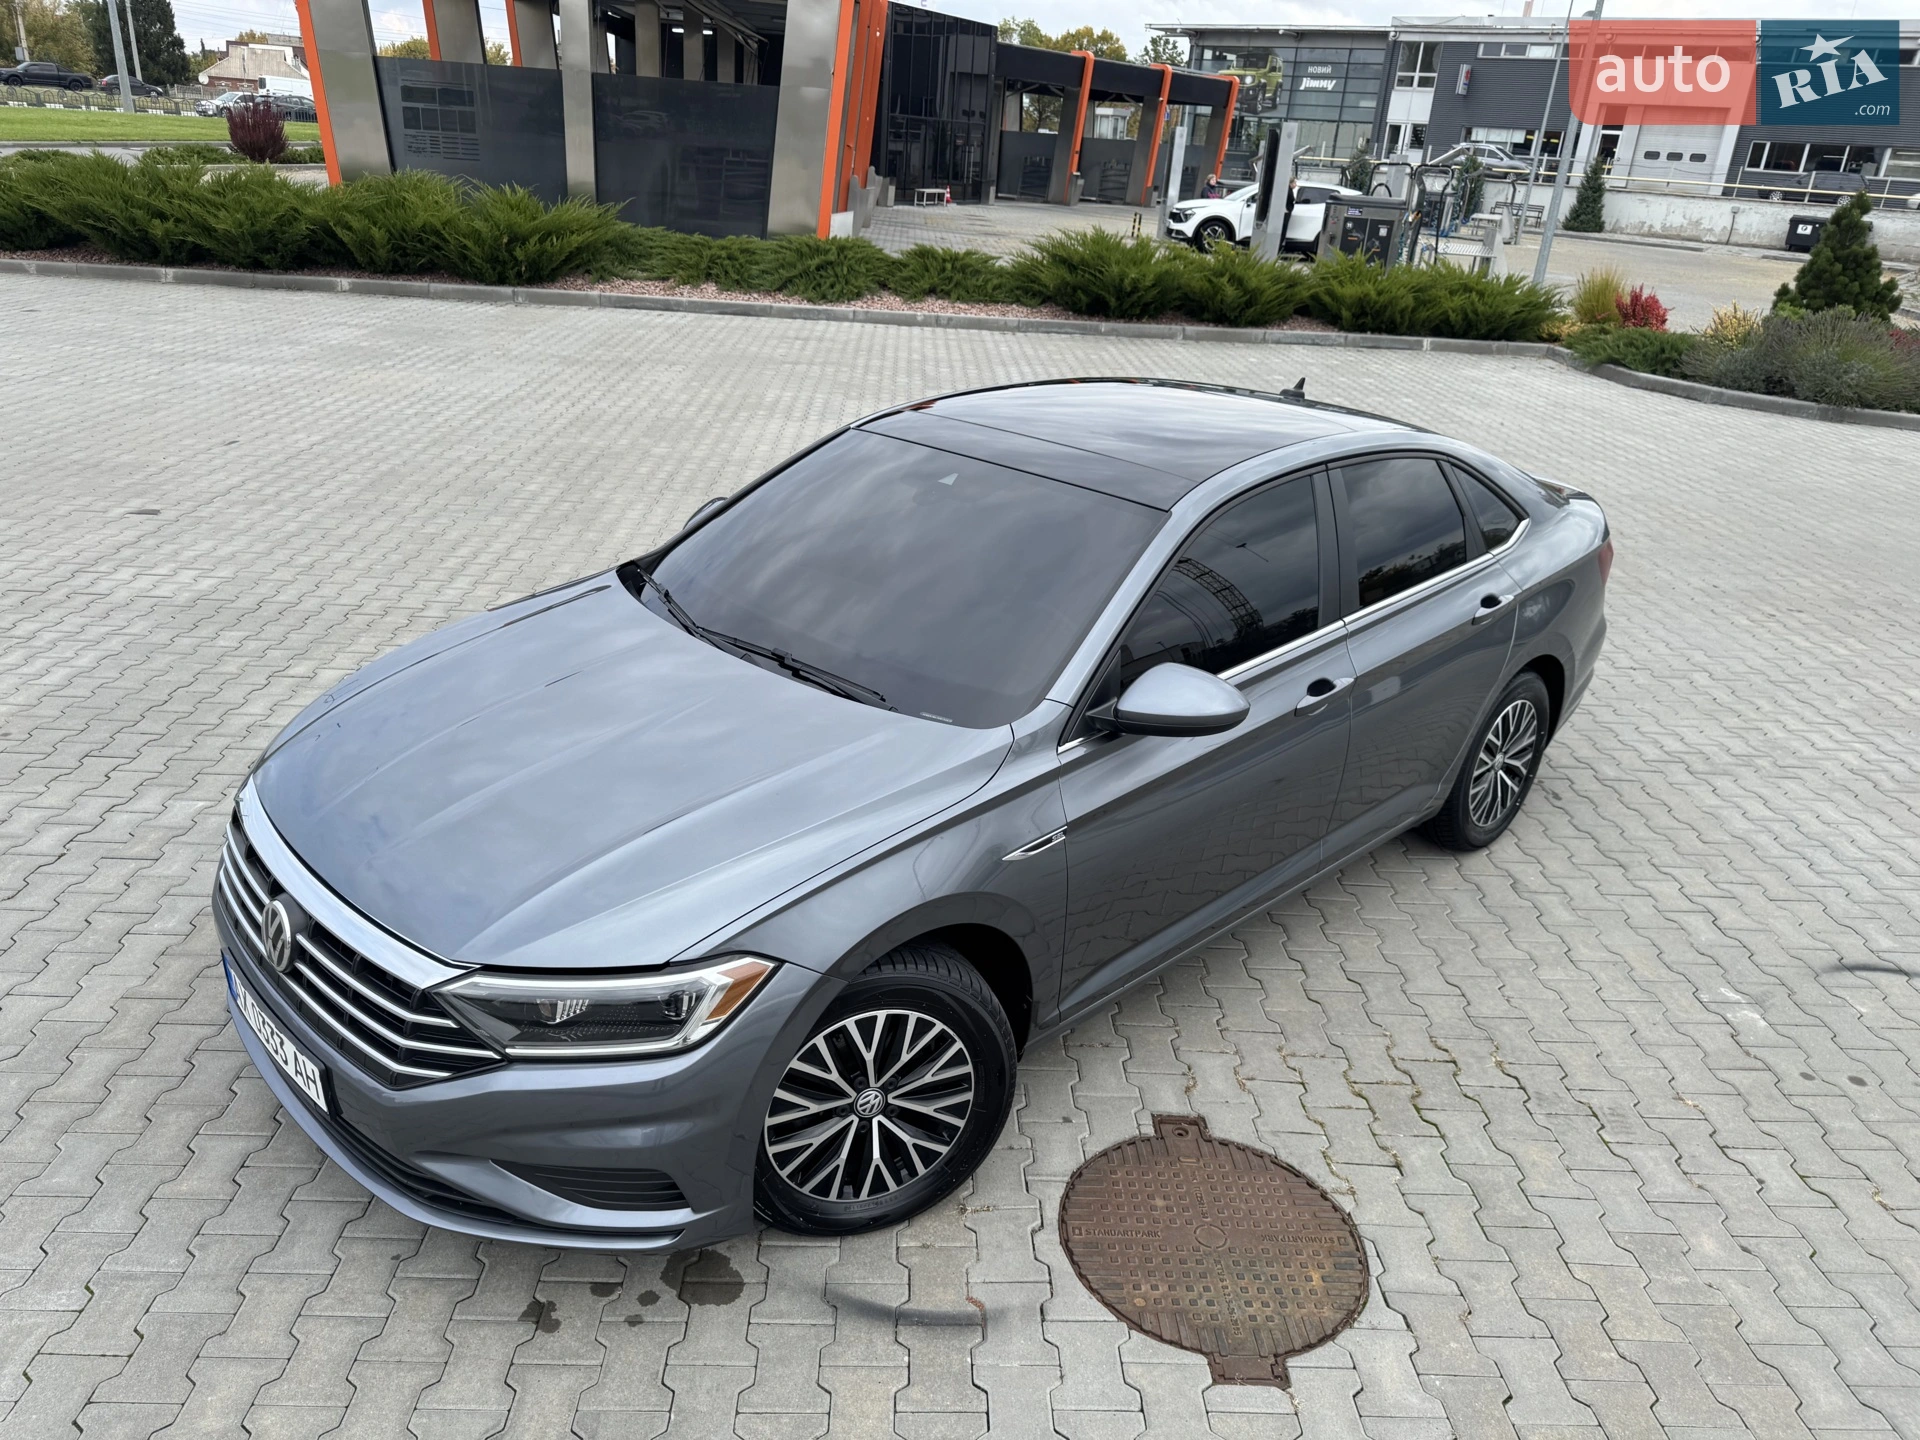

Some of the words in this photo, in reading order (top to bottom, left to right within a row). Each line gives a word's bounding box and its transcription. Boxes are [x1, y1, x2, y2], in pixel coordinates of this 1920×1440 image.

[1307, 64, 1332, 74] НОВИЙ
[251, 1001, 288, 1067] 0333
[294, 1050, 320, 1100] AH
[1085, 1227, 1160, 1238] STANDARTPARK
